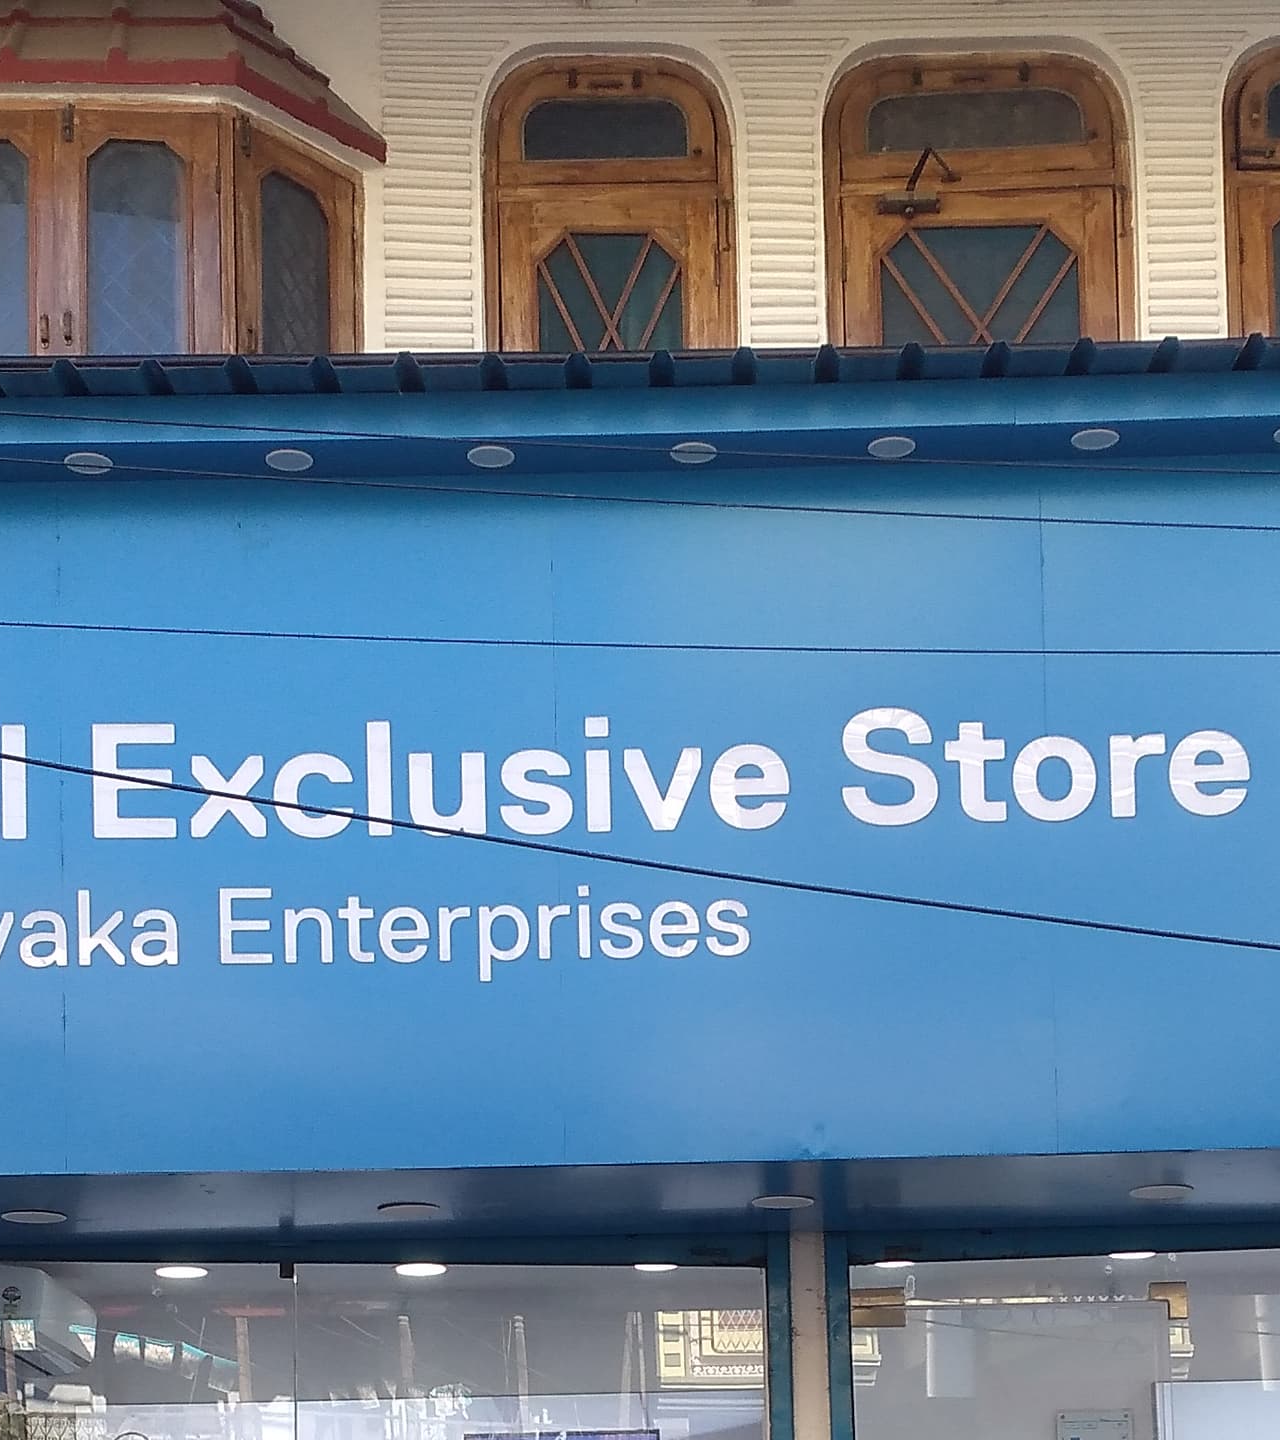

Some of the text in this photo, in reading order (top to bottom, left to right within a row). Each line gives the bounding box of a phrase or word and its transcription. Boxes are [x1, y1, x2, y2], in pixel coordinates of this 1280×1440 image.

[94, 714, 792, 842] Exclusive
[841, 706, 1253, 831] Store
[217, 883, 752, 984] Enterprises
